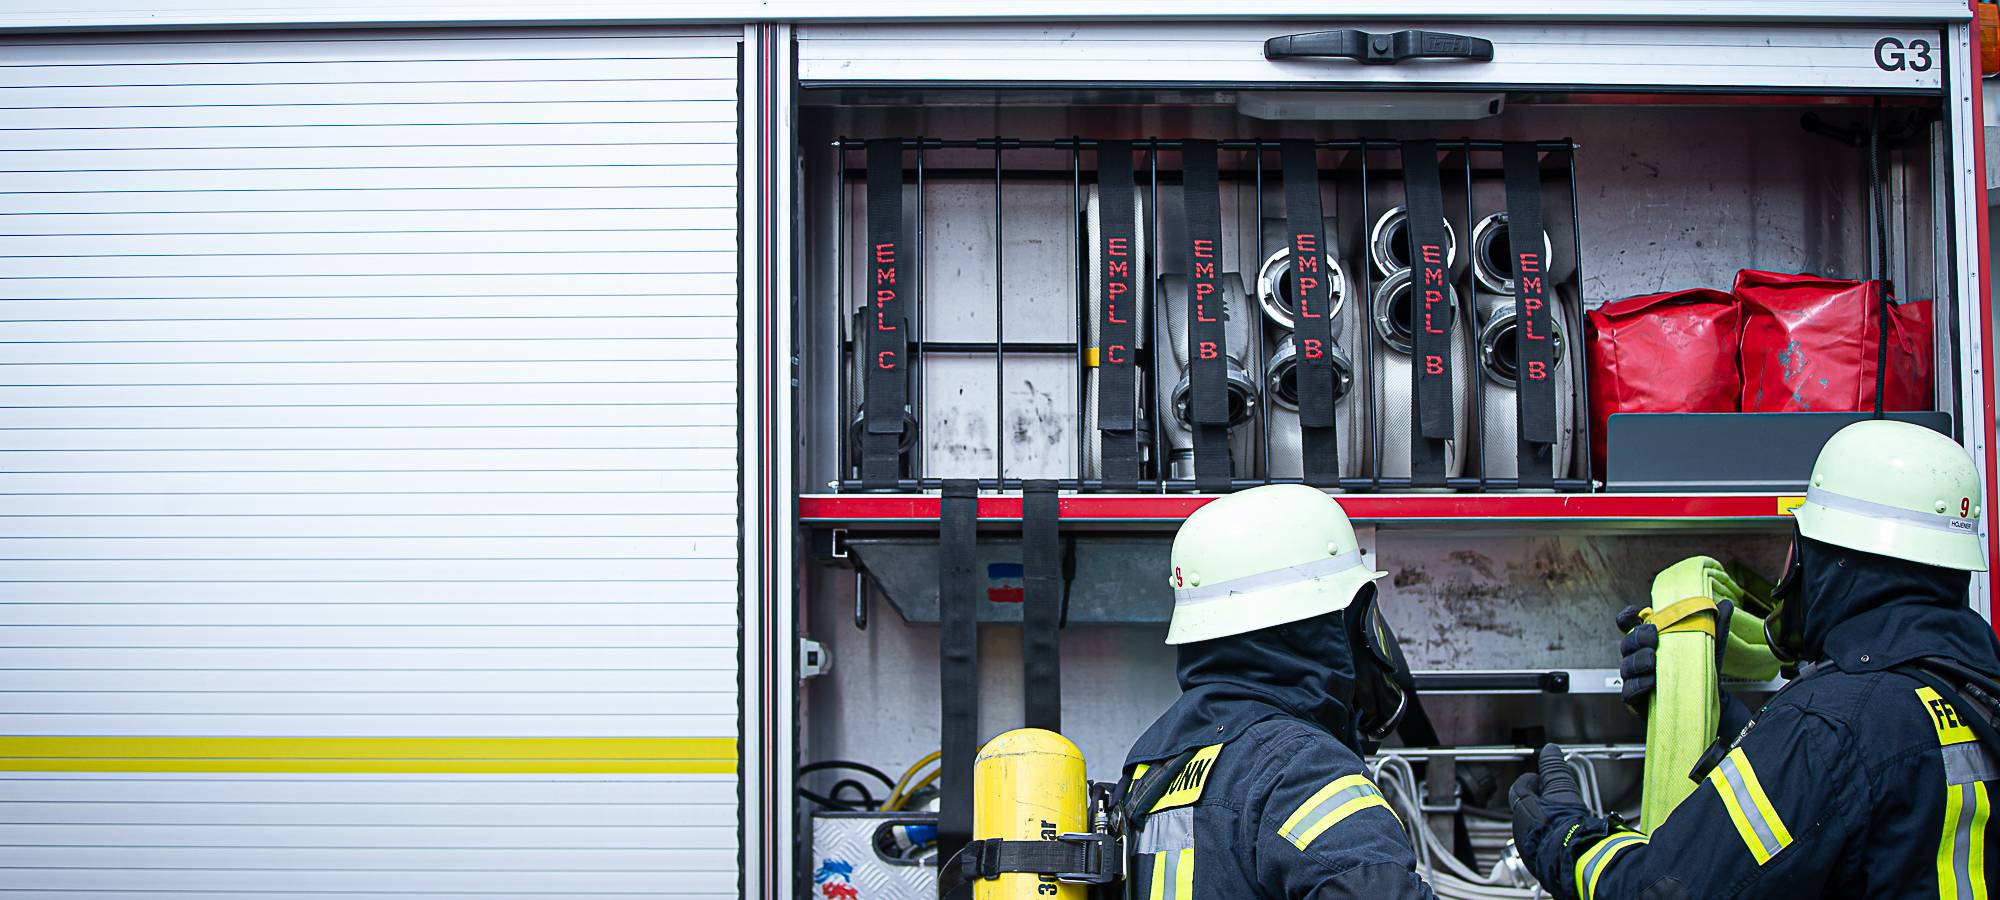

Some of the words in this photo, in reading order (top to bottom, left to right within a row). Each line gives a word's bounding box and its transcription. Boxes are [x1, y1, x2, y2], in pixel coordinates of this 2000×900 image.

[1874, 36, 1933, 73] G3
[876, 243, 896, 331] EMPL
[1108, 238, 1128, 325] EMPL
[1194, 239, 1217, 322] EMPL
[1296, 234, 1319, 319] EMPL
[1422, 245, 1443, 335] EMPL
[1519, 254, 1545, 341] EMPL
[878, 351, 895, 369] C
[1108, 344, 1125, 363] C
[1199, 341, 1217, 359] B
[1304, 340, 1323, 359] B
[1425, 355, 1444, 375] B
[1528, 361, 1547, 380] B
[1960, 497, 1970, 518] 9
[1168, 758, 1212, 795] ONN
